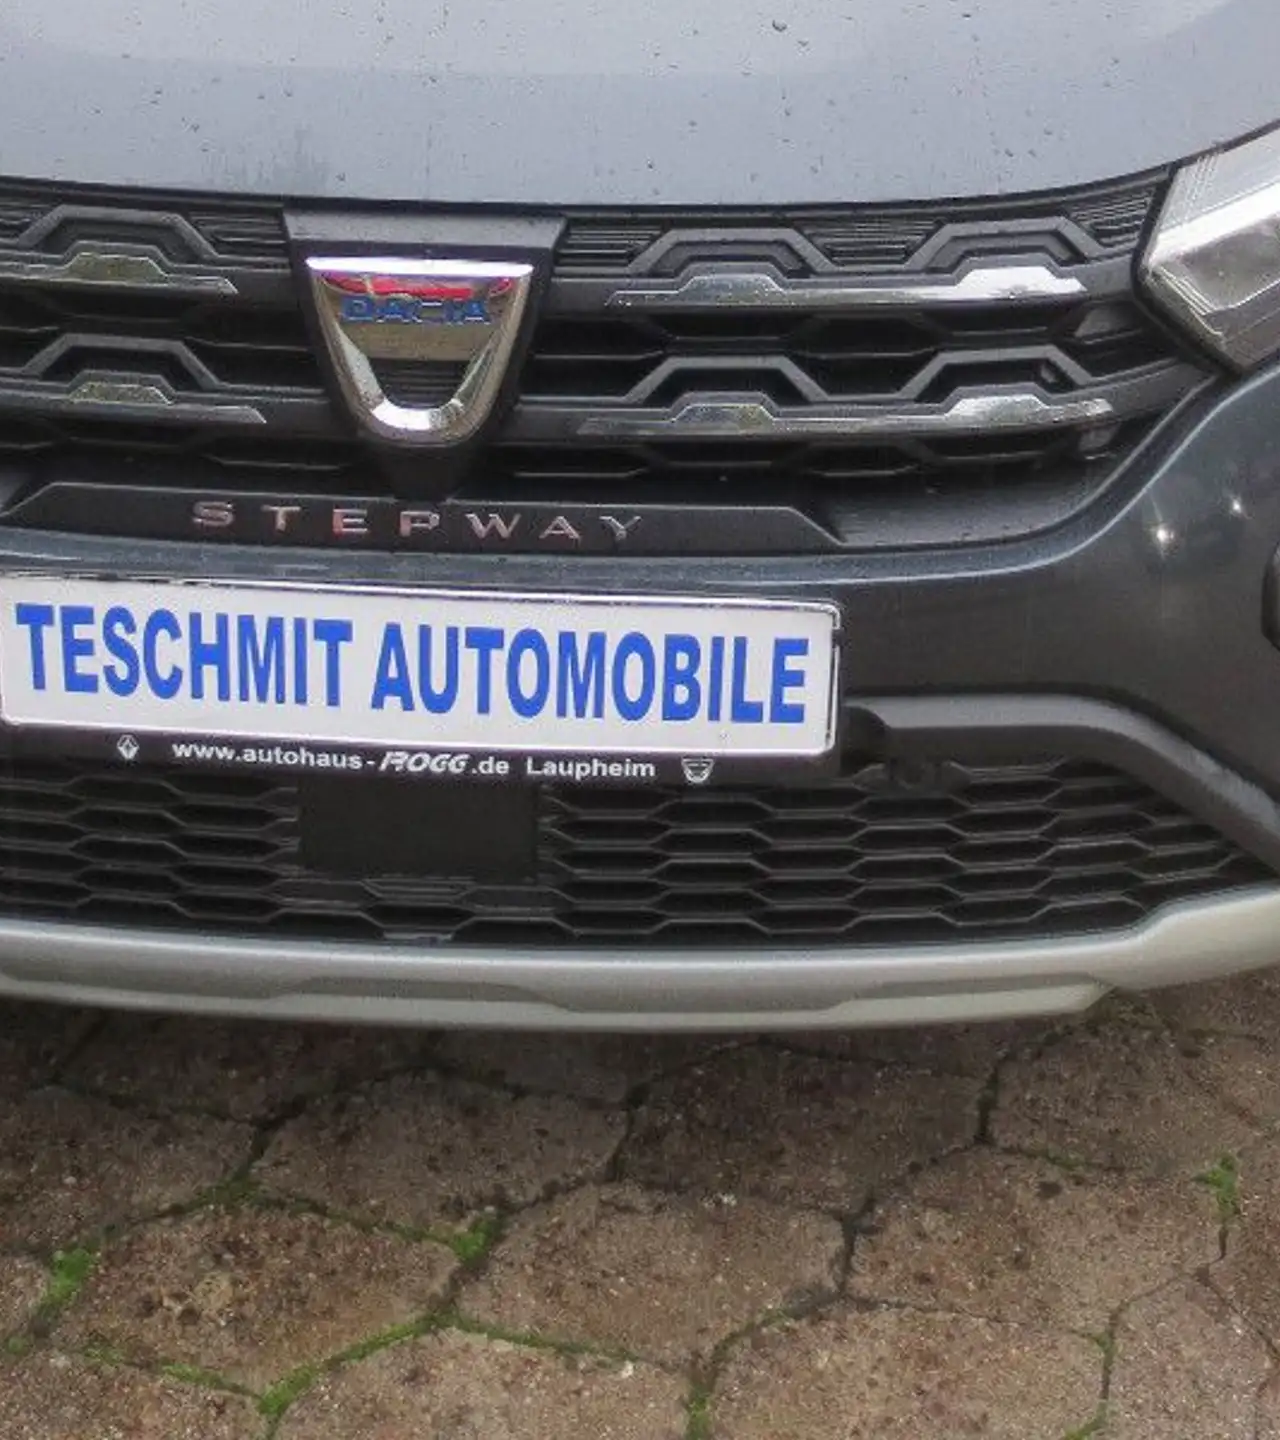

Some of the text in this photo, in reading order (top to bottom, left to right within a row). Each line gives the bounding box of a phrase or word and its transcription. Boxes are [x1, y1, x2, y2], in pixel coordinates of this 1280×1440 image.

[191, 500, 642, 541] STEPWAY
[15, 602, 810, 724] TESCHMIT AUTOMOBILE
[526, 756, 657, 781] Laupheim
